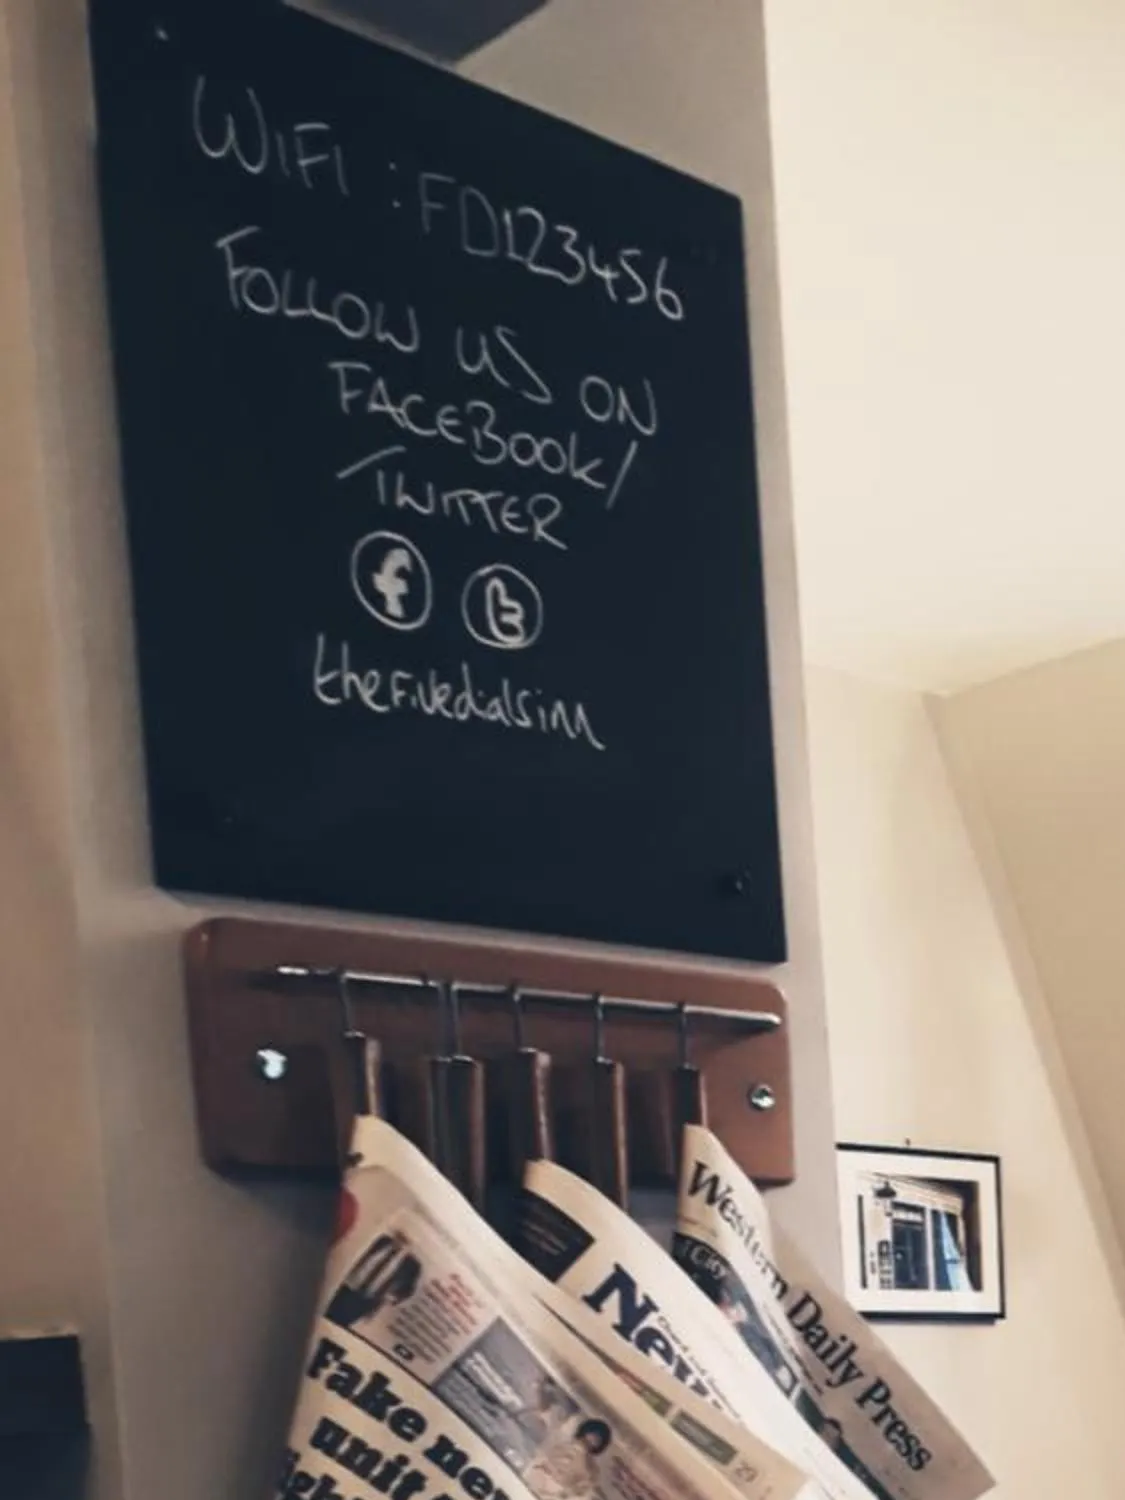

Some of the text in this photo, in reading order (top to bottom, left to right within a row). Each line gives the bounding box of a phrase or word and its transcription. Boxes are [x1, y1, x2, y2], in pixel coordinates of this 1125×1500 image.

[215, 226, 658, 436] FOLLOW US ON
[336, 445, 569, 551] TWITTER
[307, 1337, 428, 1443] Fake
[688, 1159, 790, 1300] Western
[787, 1291, 865, 1389] Daily
[855, 1376, 932, 1471] Press
